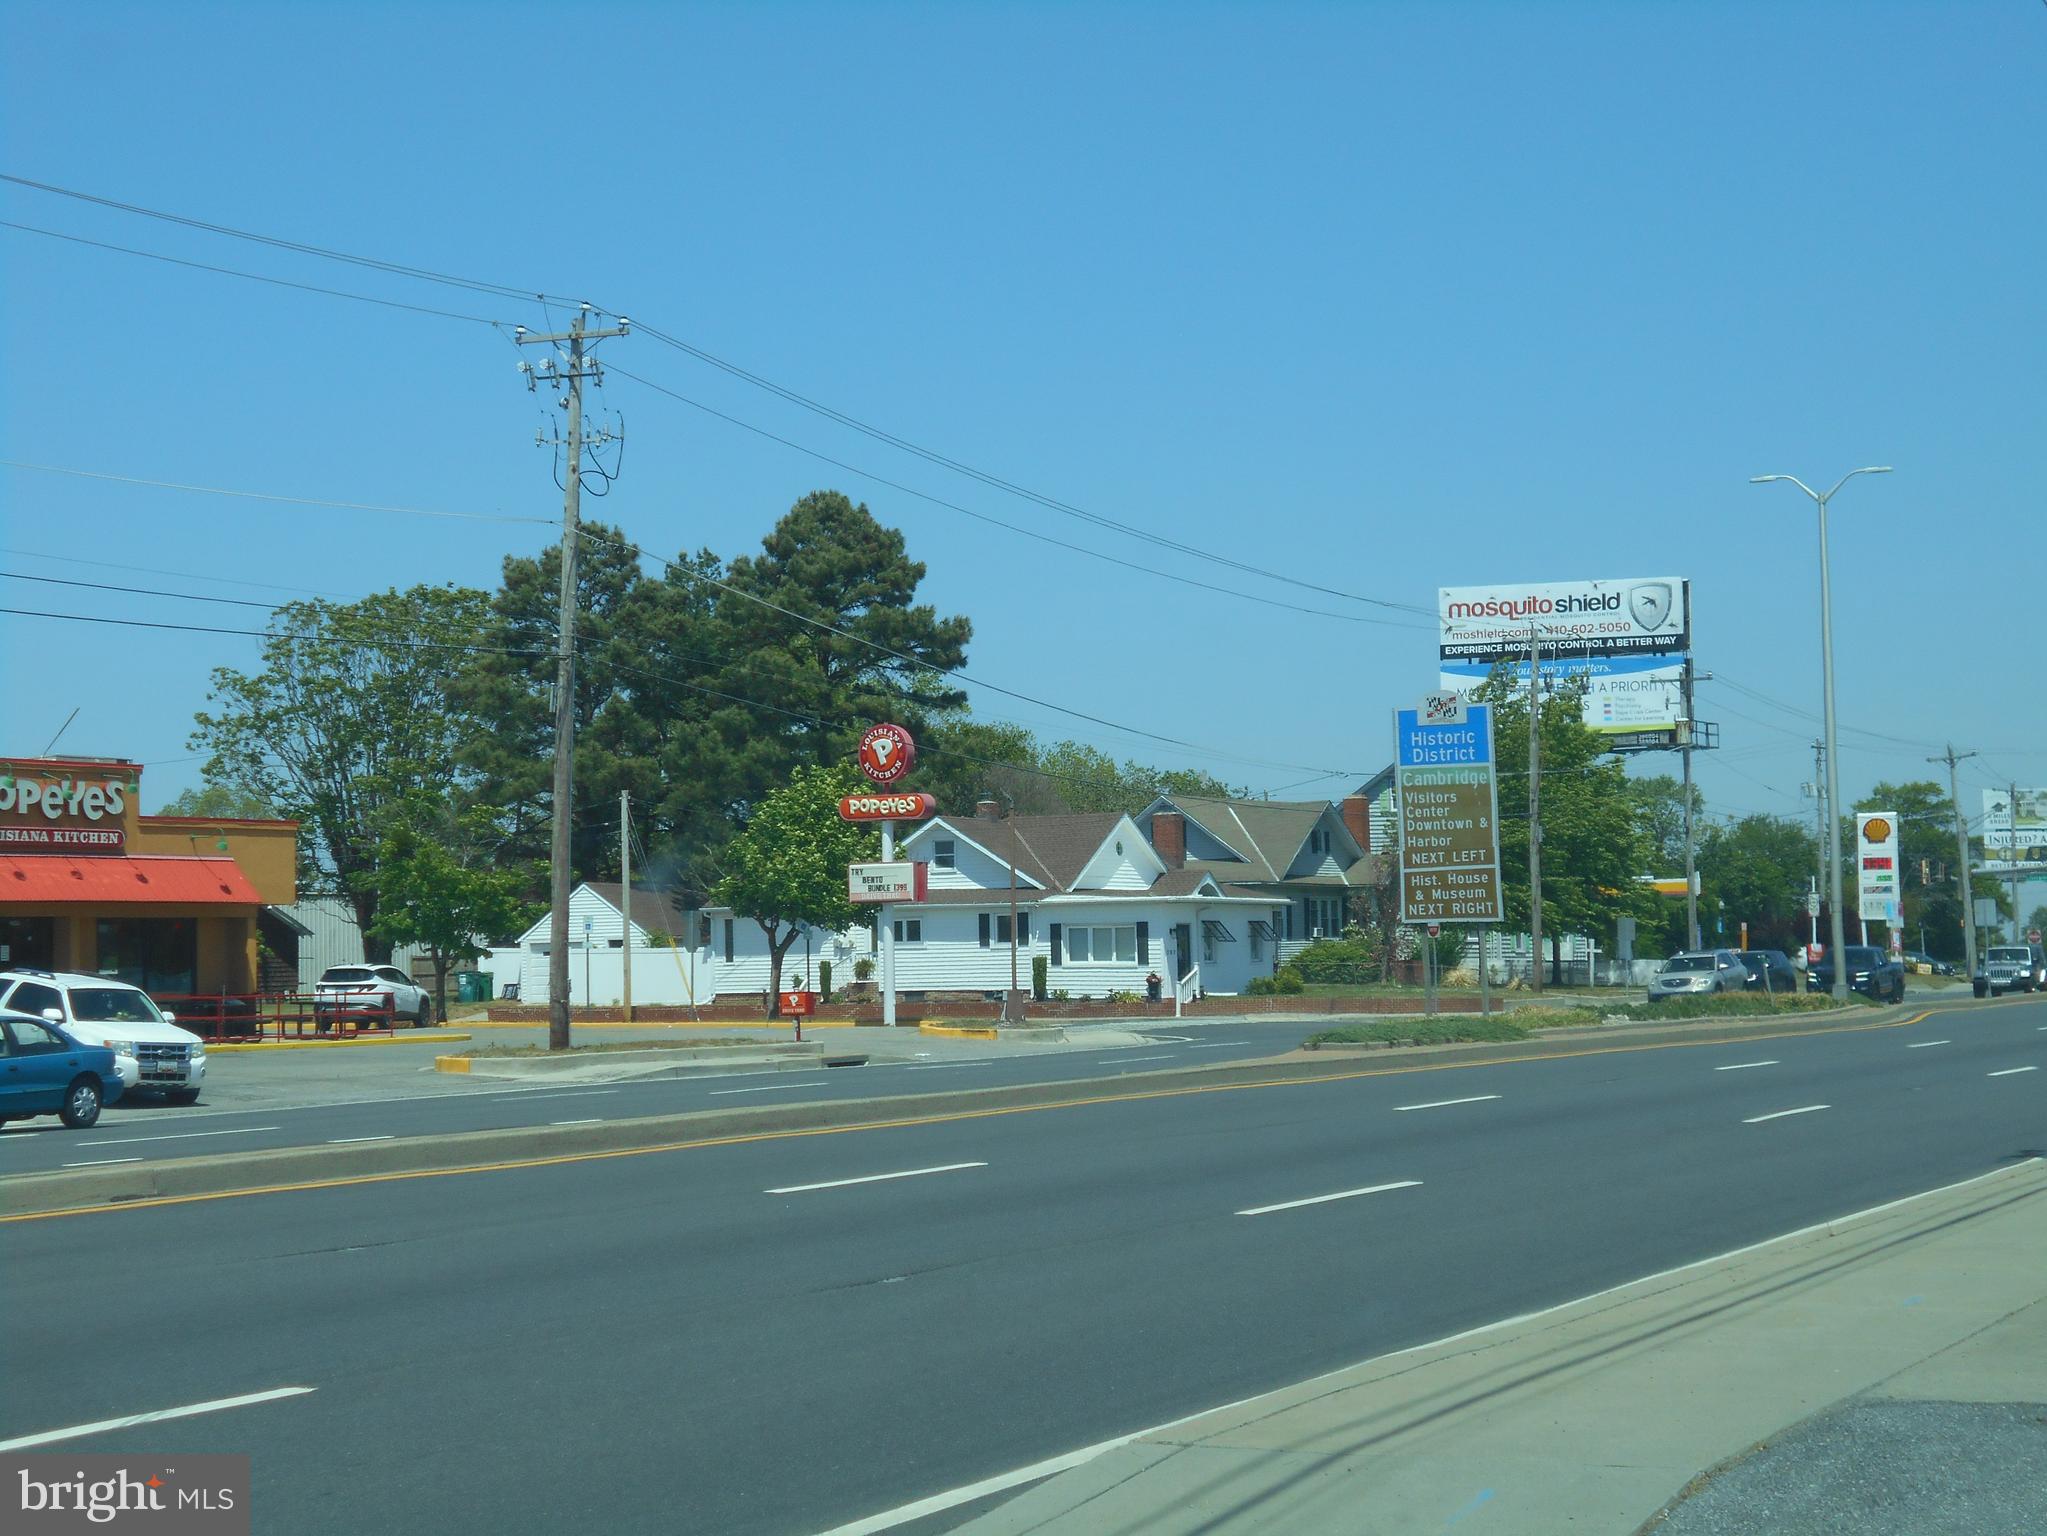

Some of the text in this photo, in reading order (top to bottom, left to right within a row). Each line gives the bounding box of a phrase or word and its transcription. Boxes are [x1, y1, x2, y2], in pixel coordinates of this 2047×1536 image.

[1448, 592, 1621, 620] mosquito shield
[1445, 636, 1677, 655] EXPERIENCE MOSQITO CONTROL A BETTER WAY
[1611, 680, 1666, 692] PRIORITY
[861, 728, 903, 751] LOUISIANA
[1411, 730, 1476, 746] Historic
[871, 738, 893, 766] P
[1413, 746, 1476, 763] District
[863, 760, 902, 779] KITCHEN
[1402, 769, 1488, 789] Cambridge
[1405, 792, 1457, 804] Visitors
[1406, 805, 1450, 818] Center
[1407, 817, 1488, 832] Downtown &
[53, 831, 119, 844] KITCHEN
[1407, 836, 1453, 848] Harbor
[1412, 849, 1486, 865] NEXT LEFT
[851, 868, 864, 876] TRY
[862, 875, 884, 884] BENTO
[1411, 873, 1489, 886] Hist. House
[867, 884, 891, 892] BUNDLE
[1415, 888, 1486, 901] & Museum
[1409, 901, 1493, 915] NEXT RIGHT
